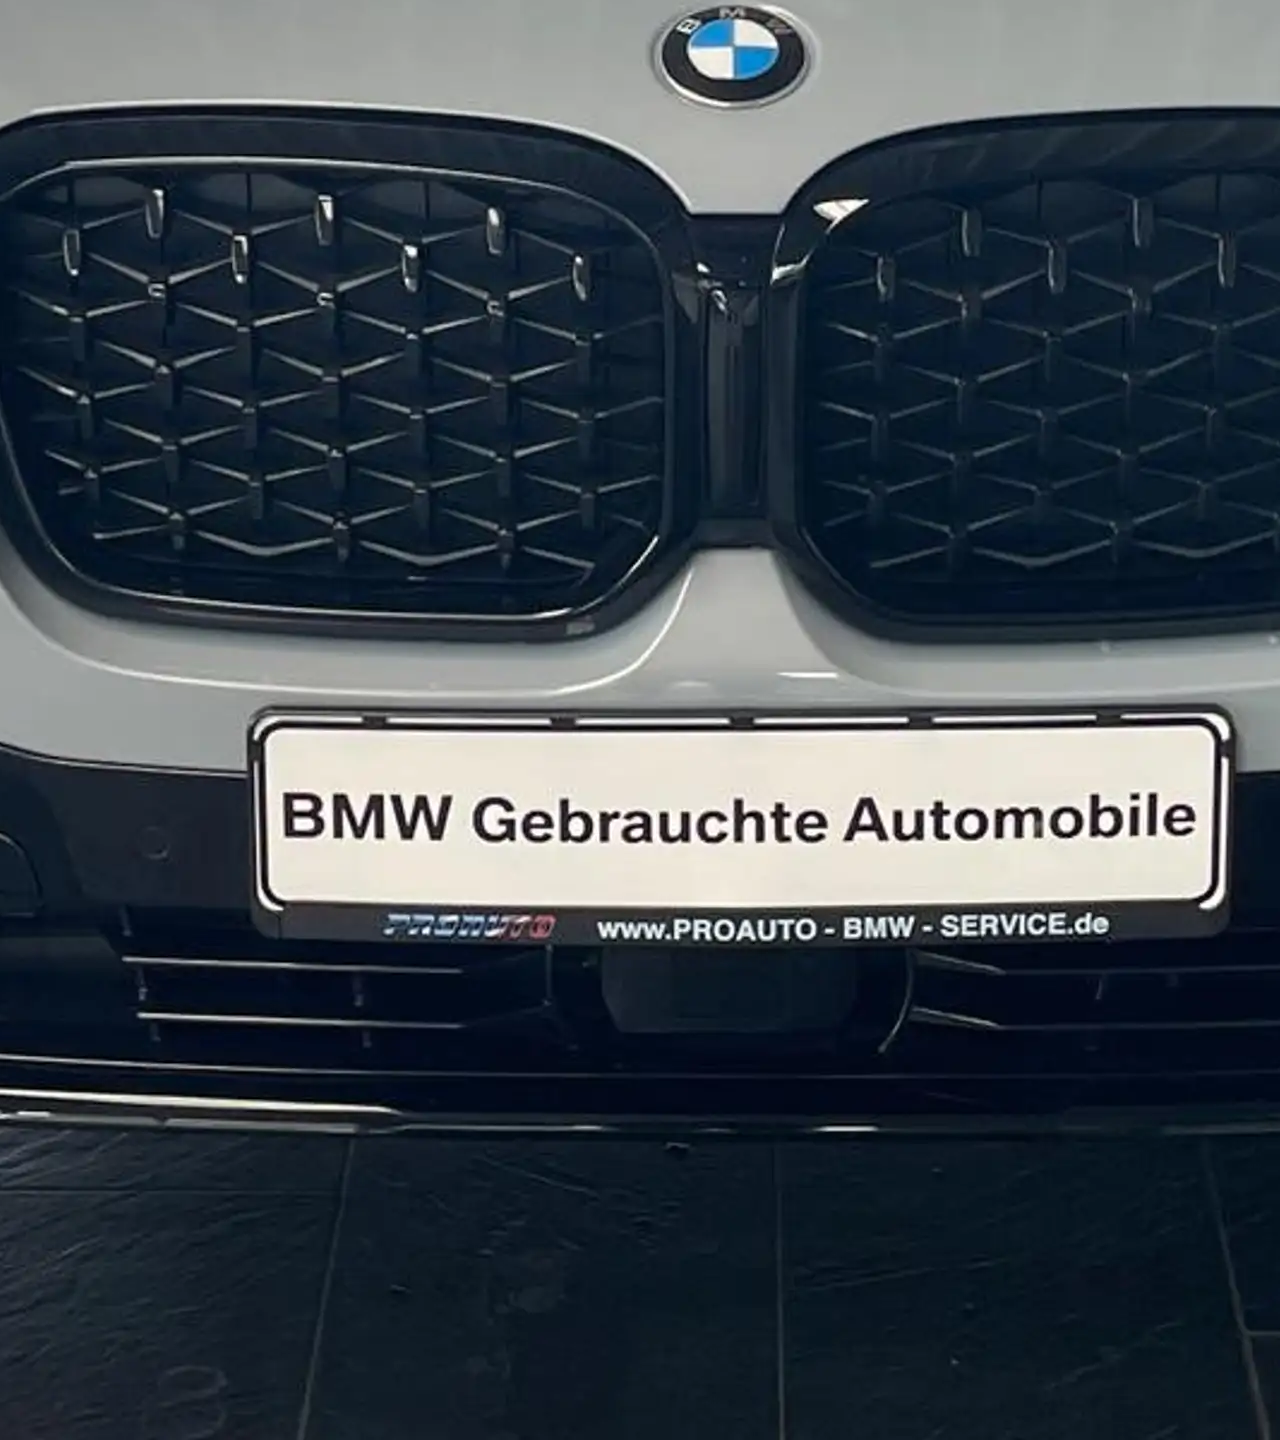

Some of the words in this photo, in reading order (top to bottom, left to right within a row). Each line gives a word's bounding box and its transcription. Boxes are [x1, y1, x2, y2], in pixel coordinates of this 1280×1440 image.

[677, 6, 793, 36] BMW
[282, 792, 453, 841] BMW
[473, 797, 828, 844] Gebrauchte
[843, 792, 1196, 842] Automobile
